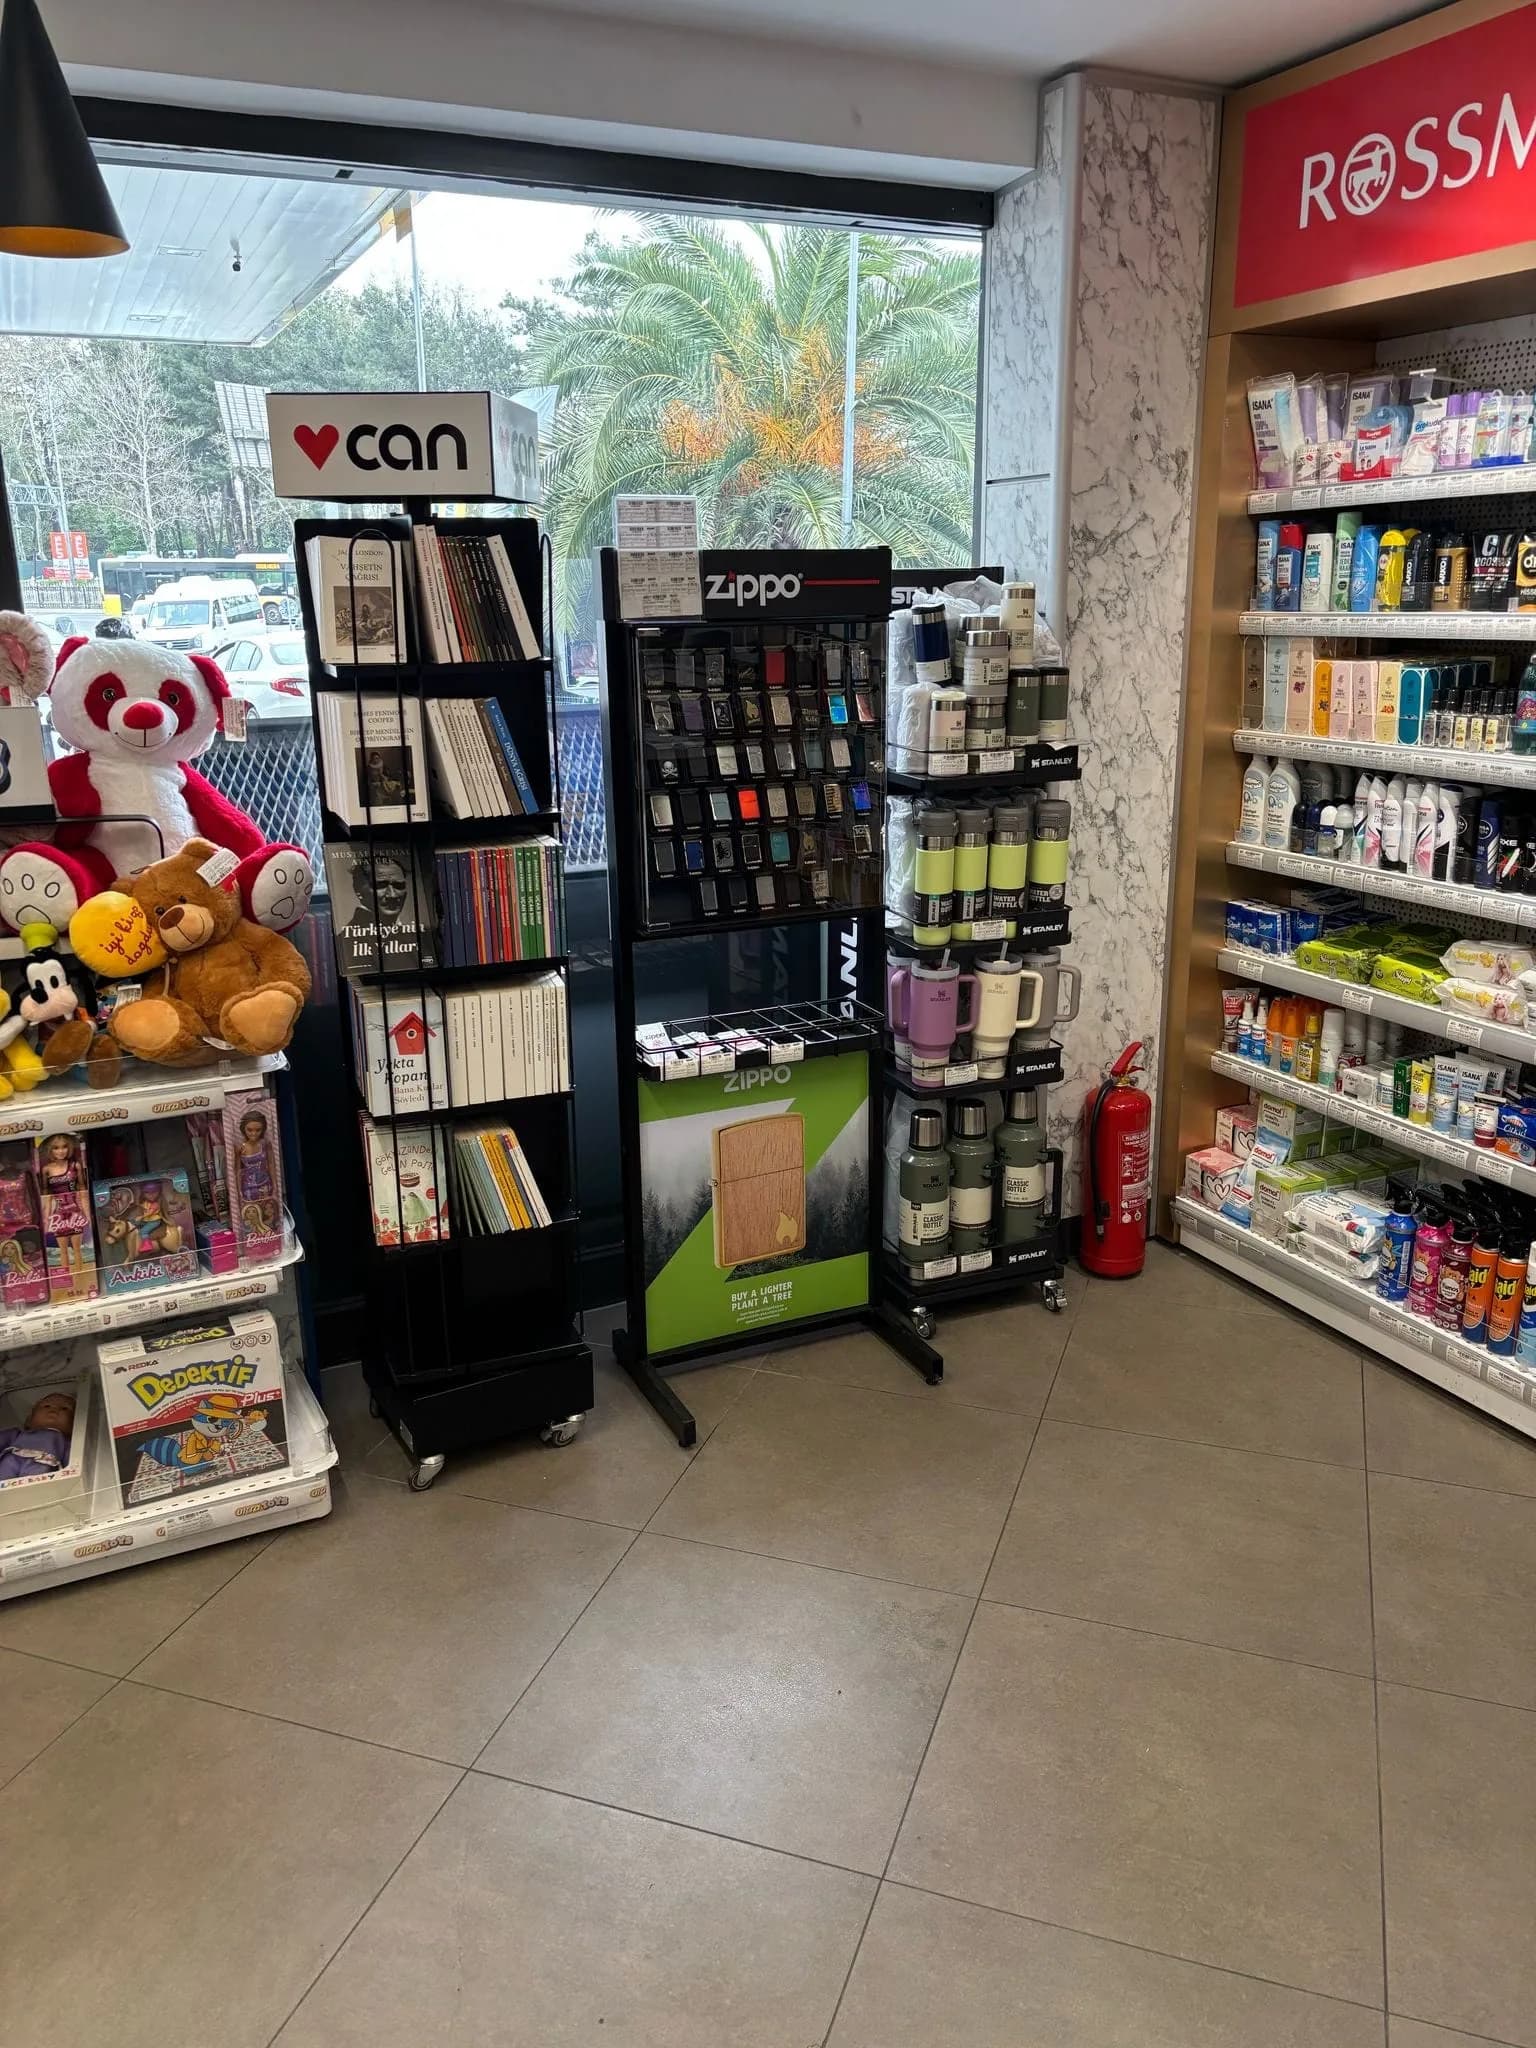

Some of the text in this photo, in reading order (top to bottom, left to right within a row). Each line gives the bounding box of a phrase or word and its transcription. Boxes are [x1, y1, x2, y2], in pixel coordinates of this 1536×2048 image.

[1252, 399, 1273, 411] ISANA
[346, 423, 468, 471] can
[1041, 757, 1073, 768] STANLEY
[1032, 923, 1064, 934] STANLEY
[1026, 1062, 1056, 1073] STANLEY
[724, 1064, 792, 1093] ZIPPO
[1462, 1070, 1481, 1081] ISANA
[417, 1083, 443, 1092] Kular
[1007, 1179, 1030, 1188] CLASSIC
[1007, 1185, 1027, 1193] BOTTLE
[48, 1211, 88, 1233] Barbie
[923, 1213, 944, 1223] CLASSIC
[923, 1221, 942, 1229] BOTTLE
[1018, 1249, 1048, 1261] STANLEY
[109, 1261, 164, 1288] Ankiki
[1469, 1268, 1488, 1284] aid
[731, 1281, 793, 1303] BUY A LIGHTER
[1496, 1280, 1517, 1296] aid
[731, 1290, 793, 1312] PLANT A TREE
